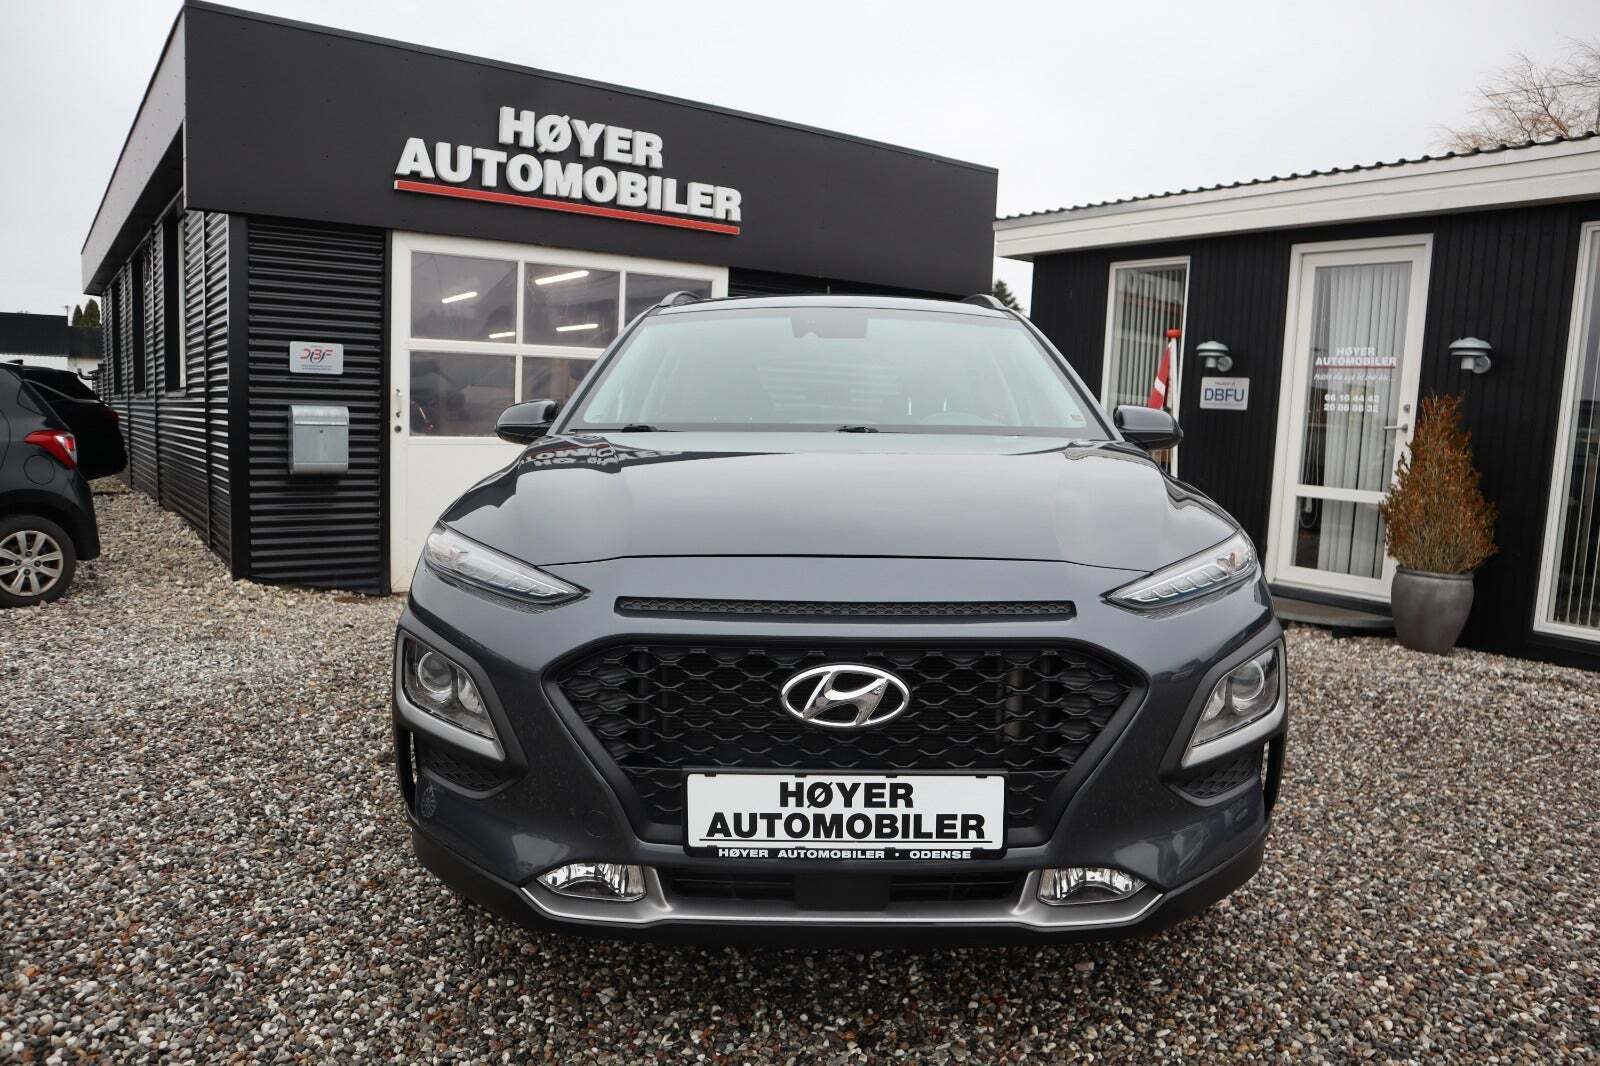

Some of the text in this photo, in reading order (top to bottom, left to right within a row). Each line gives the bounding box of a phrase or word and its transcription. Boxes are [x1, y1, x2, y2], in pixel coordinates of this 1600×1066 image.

[499, 106, 663, 168] HØYER
[395, 137, 742, 221] AUTOMOBILER
[1315, 356, 1397, 366] AUTOMOBILER
[1336, 347, 1376, 356] HØYER
[1204, 387, 1245, 402] DBFU
[779, 781, 914, 808] HØYER
[706, 812, 986, 839] AUTOMOBILER
[718, 848, 972, 860] HØYER AUTOMOBILER ODENSE
